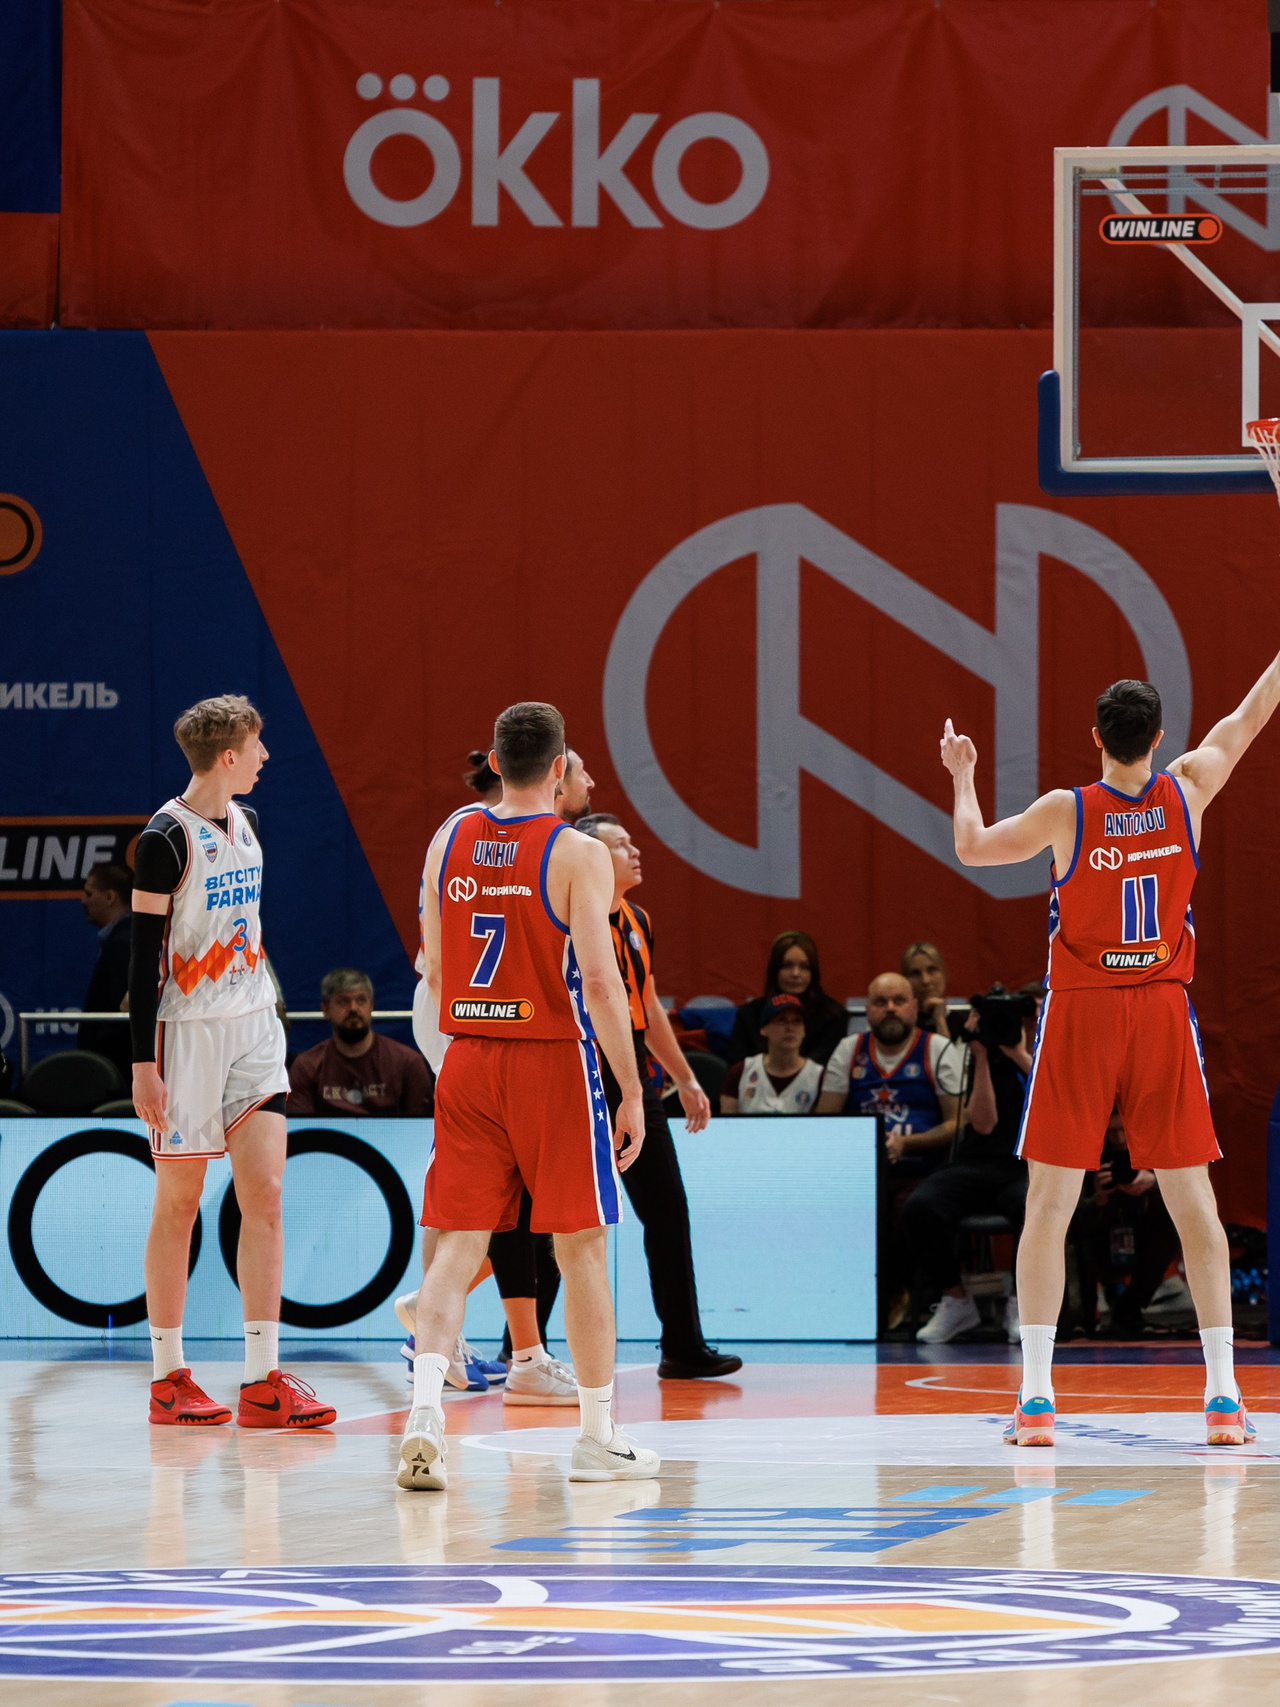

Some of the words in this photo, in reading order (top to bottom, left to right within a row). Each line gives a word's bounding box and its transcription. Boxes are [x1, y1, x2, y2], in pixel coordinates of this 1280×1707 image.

[1109, 220, 1196, 238] WINLINE
[1122, 874, 1161, 944] 11
[232, 918, 249, 952] 3
[469, 912, 506, 988] 7
[1106, 951, 1157, 967] WINLIN
[455, 1003, 517, 1018] WINLINE
